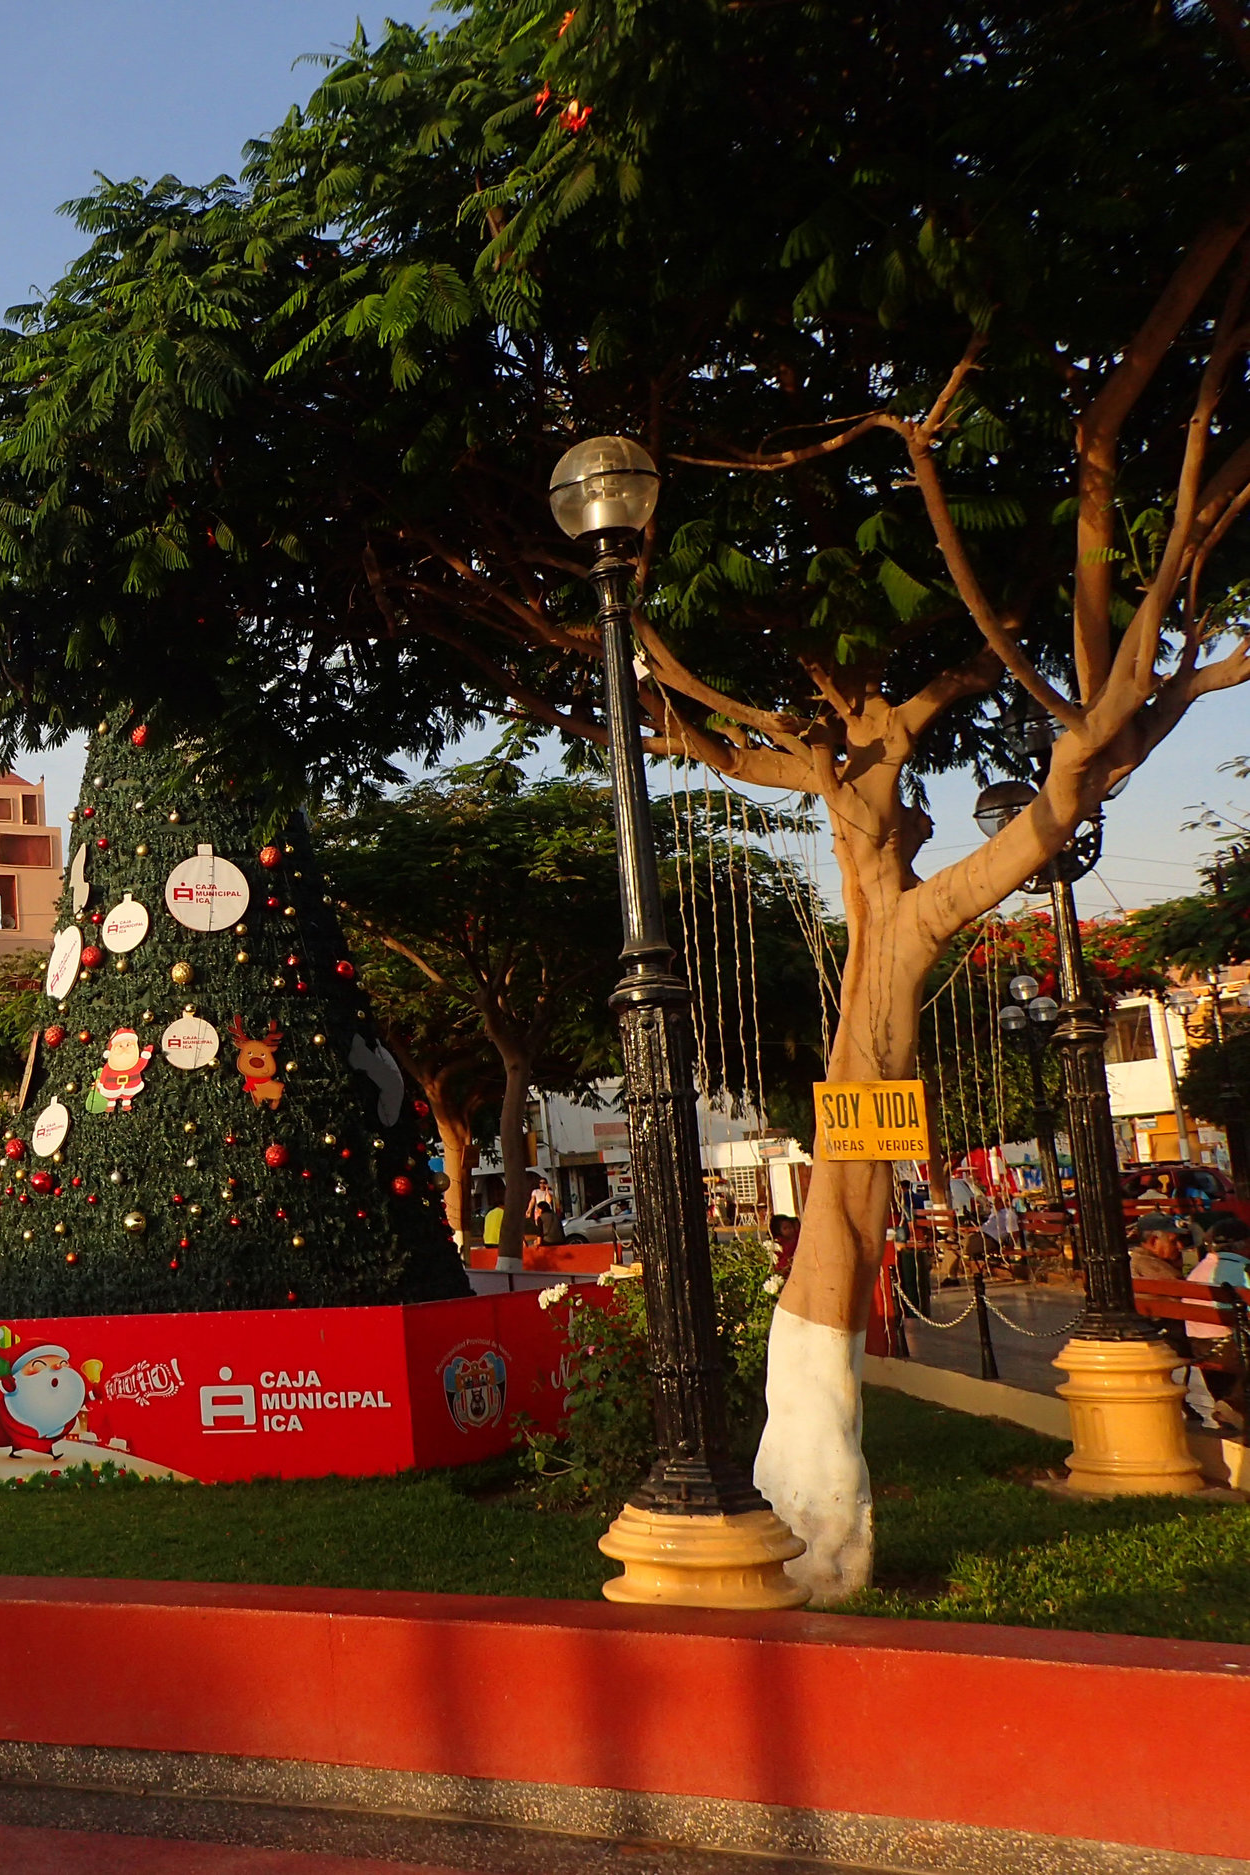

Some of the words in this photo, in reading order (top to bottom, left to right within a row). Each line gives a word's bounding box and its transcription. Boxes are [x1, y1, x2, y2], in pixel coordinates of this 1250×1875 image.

[822, 1092, 860, 1129] SOY
[873, 1091, 920, 1128] VIDA
[877, 1139, 924, 1151] VERDES
[260, 1370, 322, 1389] CAJA
[261, 1390, 392, 1411] MUNICIPAL
[263, 1414, 304, 1433] ICA
